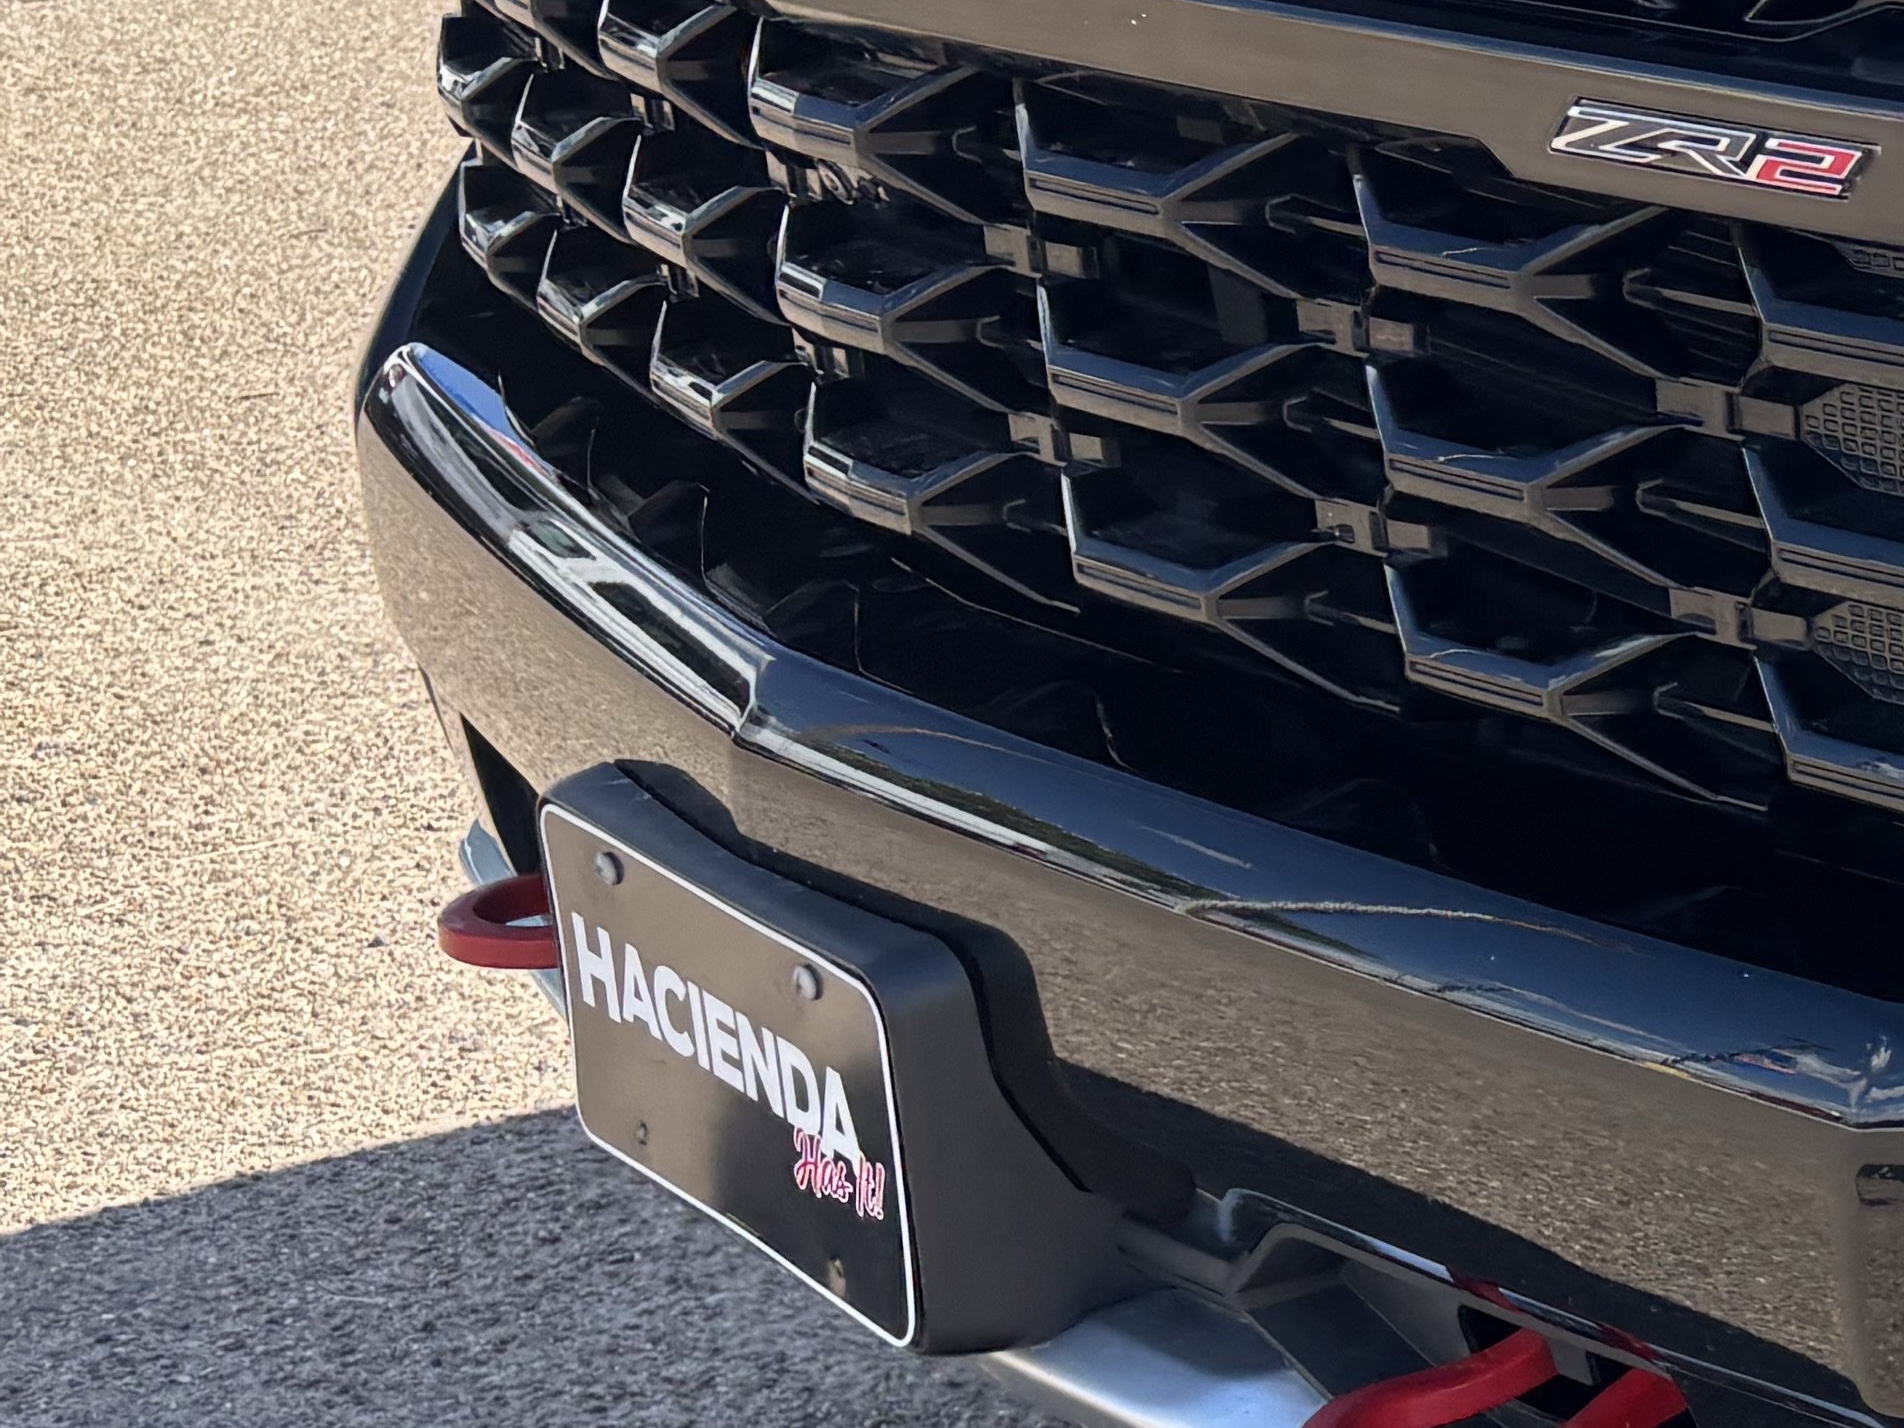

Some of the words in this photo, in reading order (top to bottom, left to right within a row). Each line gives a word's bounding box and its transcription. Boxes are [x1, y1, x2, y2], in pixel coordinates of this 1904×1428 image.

[1549, 98, 1868, 197] ZR2
[572, 911, 866, 1174] HACIENDA
[794, 1127, 853, 1203] Has
[856, 1152, 886, 1220] It!
